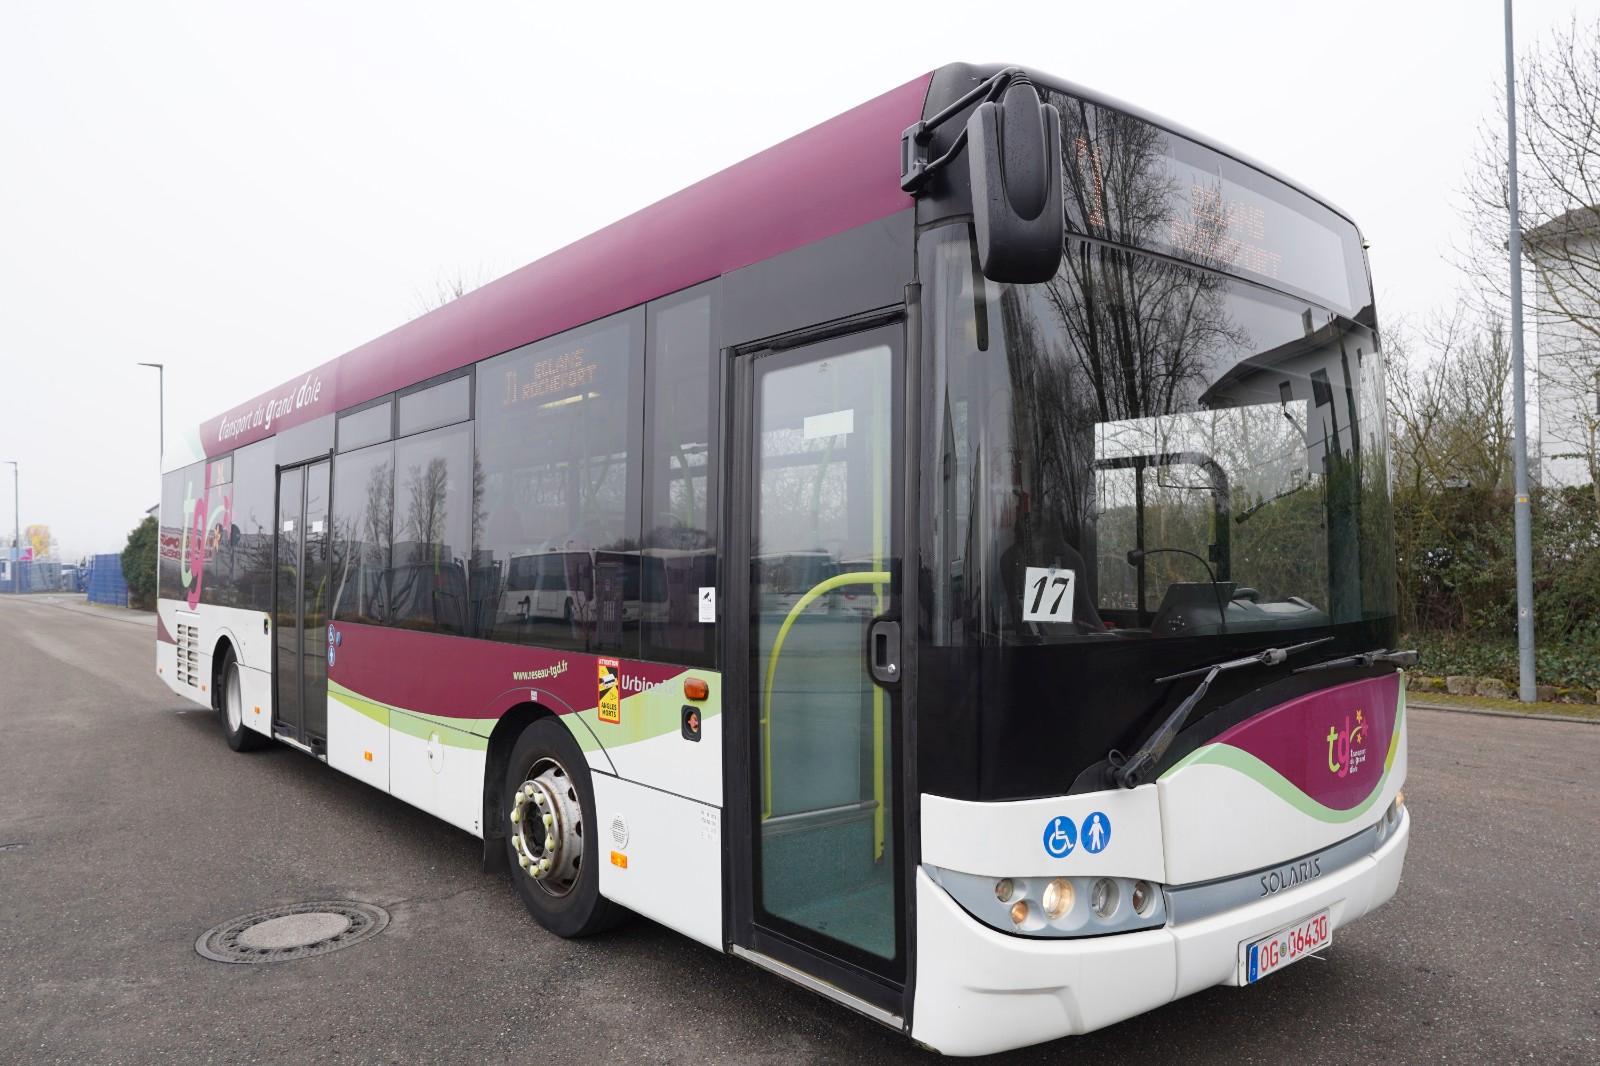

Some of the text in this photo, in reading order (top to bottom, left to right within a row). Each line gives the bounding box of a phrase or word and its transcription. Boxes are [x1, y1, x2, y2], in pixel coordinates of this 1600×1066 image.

[252, 403, 265, 428] du
[264, 388, 297, 430] grand
[1030, 575, 1070, 615] 17
[512, 659, 568, 680] www.reseau-tgd.fr
[601, 702, 618, 711] ANGLES
[601, 709, 618, 718] MORTS
[1260, 858, 1321, 897] SOLARIS
[1260, 939, 1279, 972] OG
